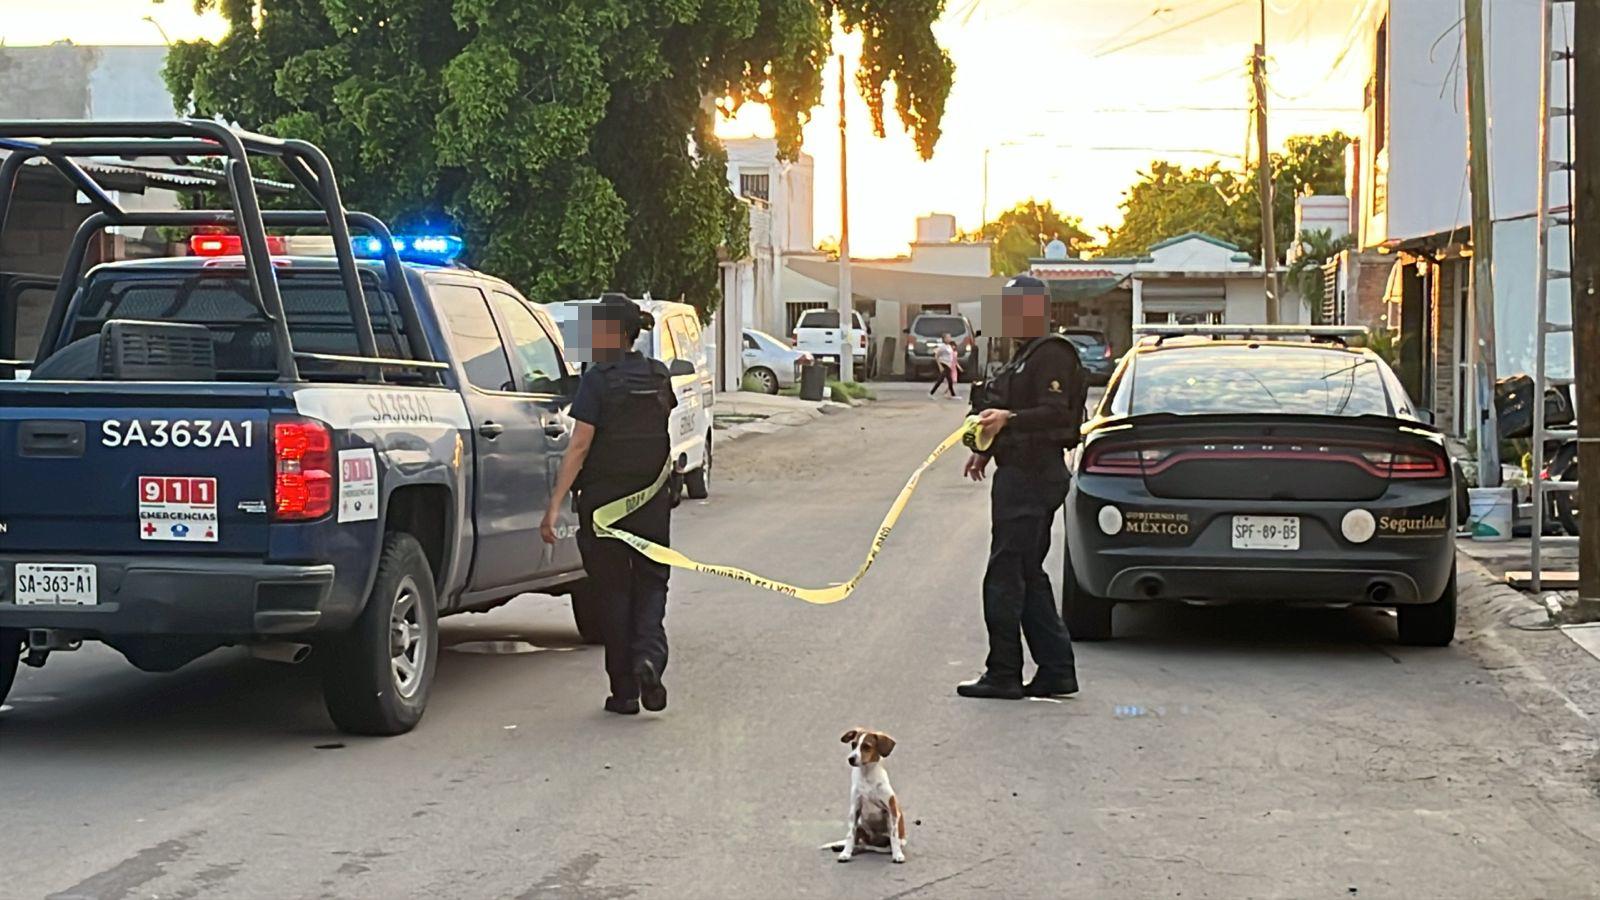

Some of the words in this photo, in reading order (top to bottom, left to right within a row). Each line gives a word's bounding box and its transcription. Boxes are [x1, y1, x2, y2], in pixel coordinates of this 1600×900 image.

[102, 419, 252, 447] SA363A1
[343, 460, 371, 480] 911
[145, 482, 208, 502] 911
[140, 511, 216, 521] EMERGENCIAS
[19, 575, 91, 593] SA-363-A1
